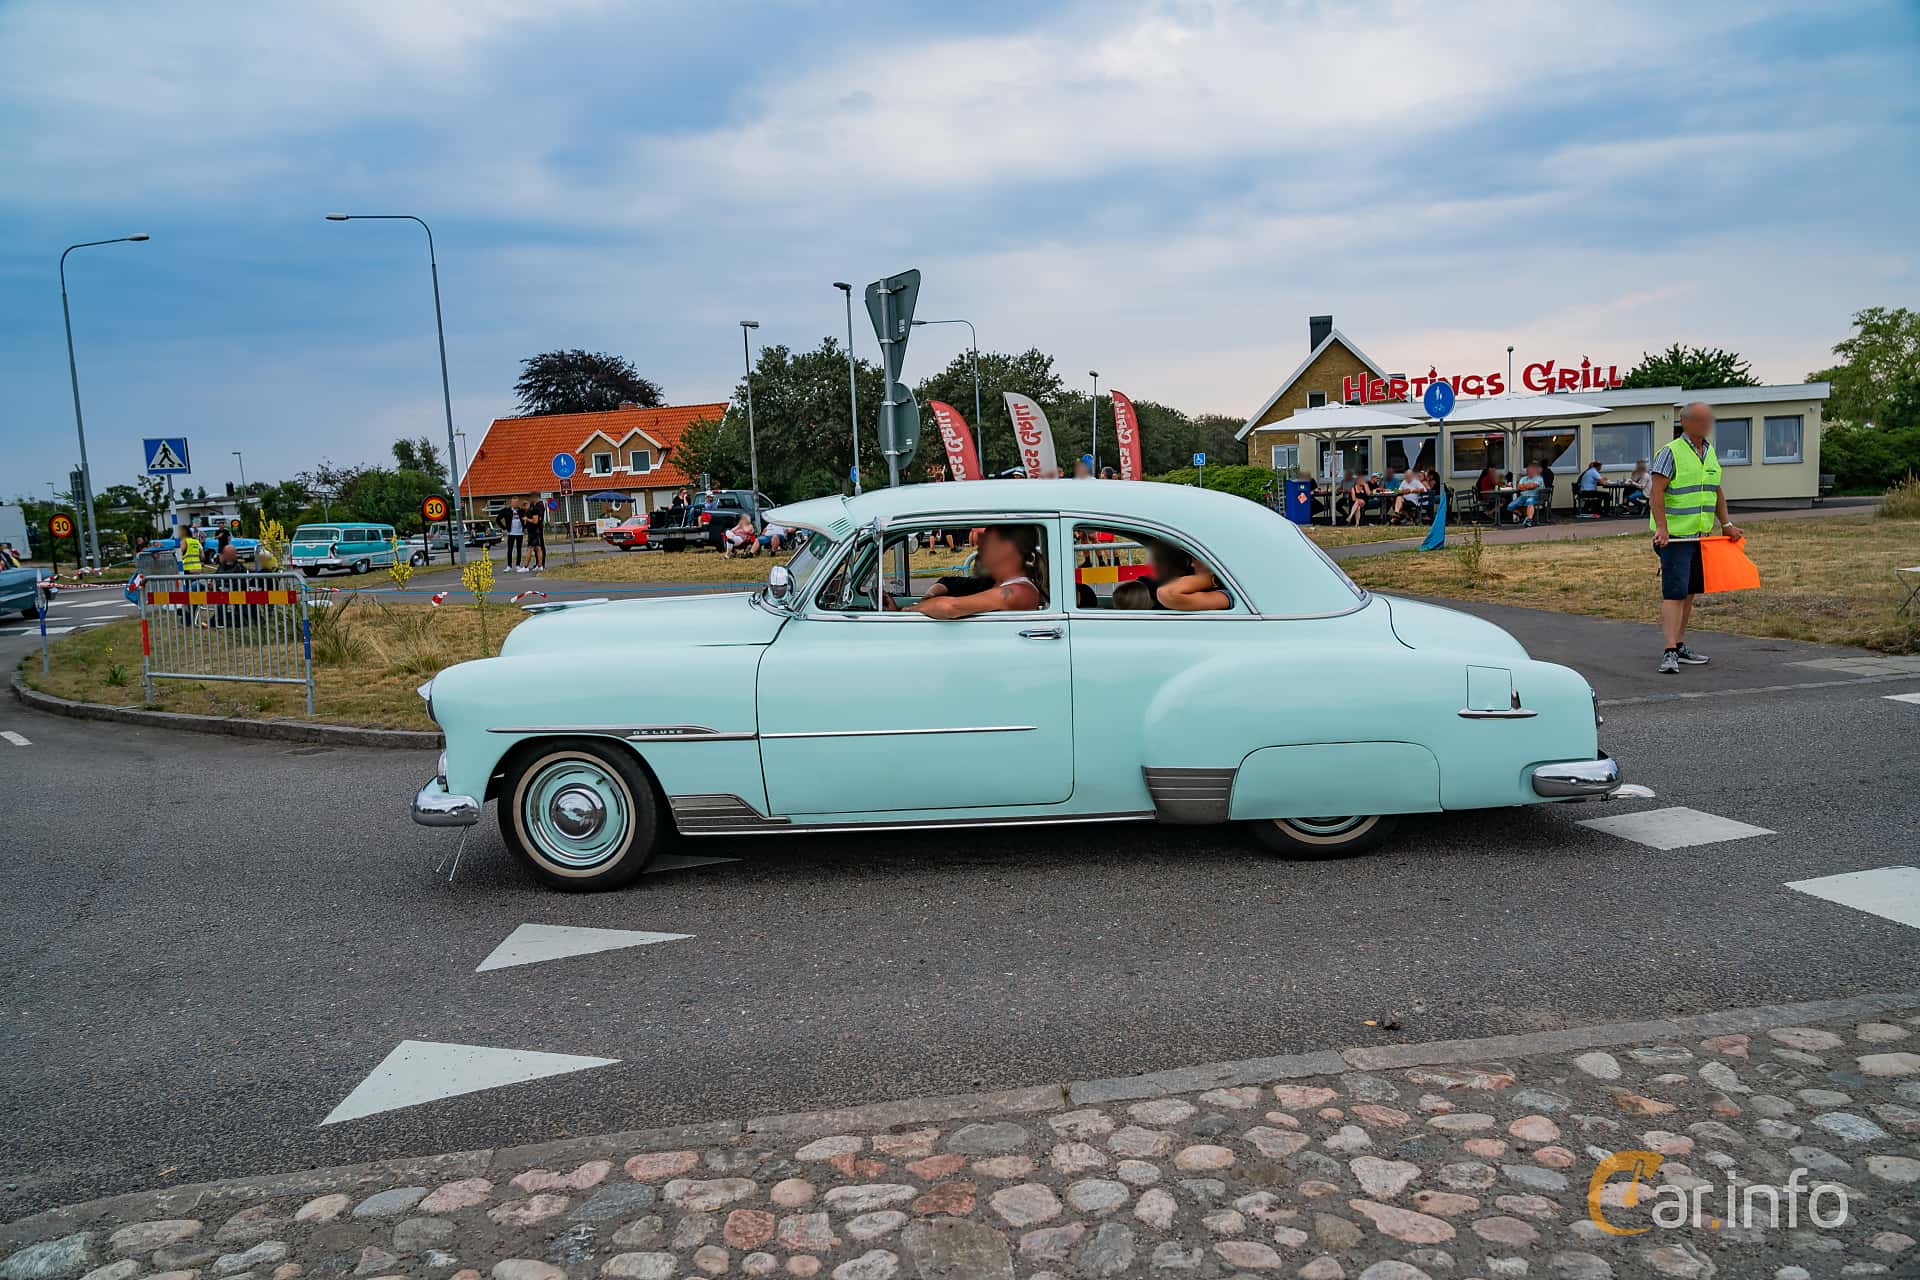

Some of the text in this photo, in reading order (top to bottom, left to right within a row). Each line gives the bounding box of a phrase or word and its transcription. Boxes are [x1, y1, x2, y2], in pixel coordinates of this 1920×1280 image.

[1522, 357, 1624, 395] GRILL
[427, 502, 443, 515] 30
[55, 520, 69, 532] 30
